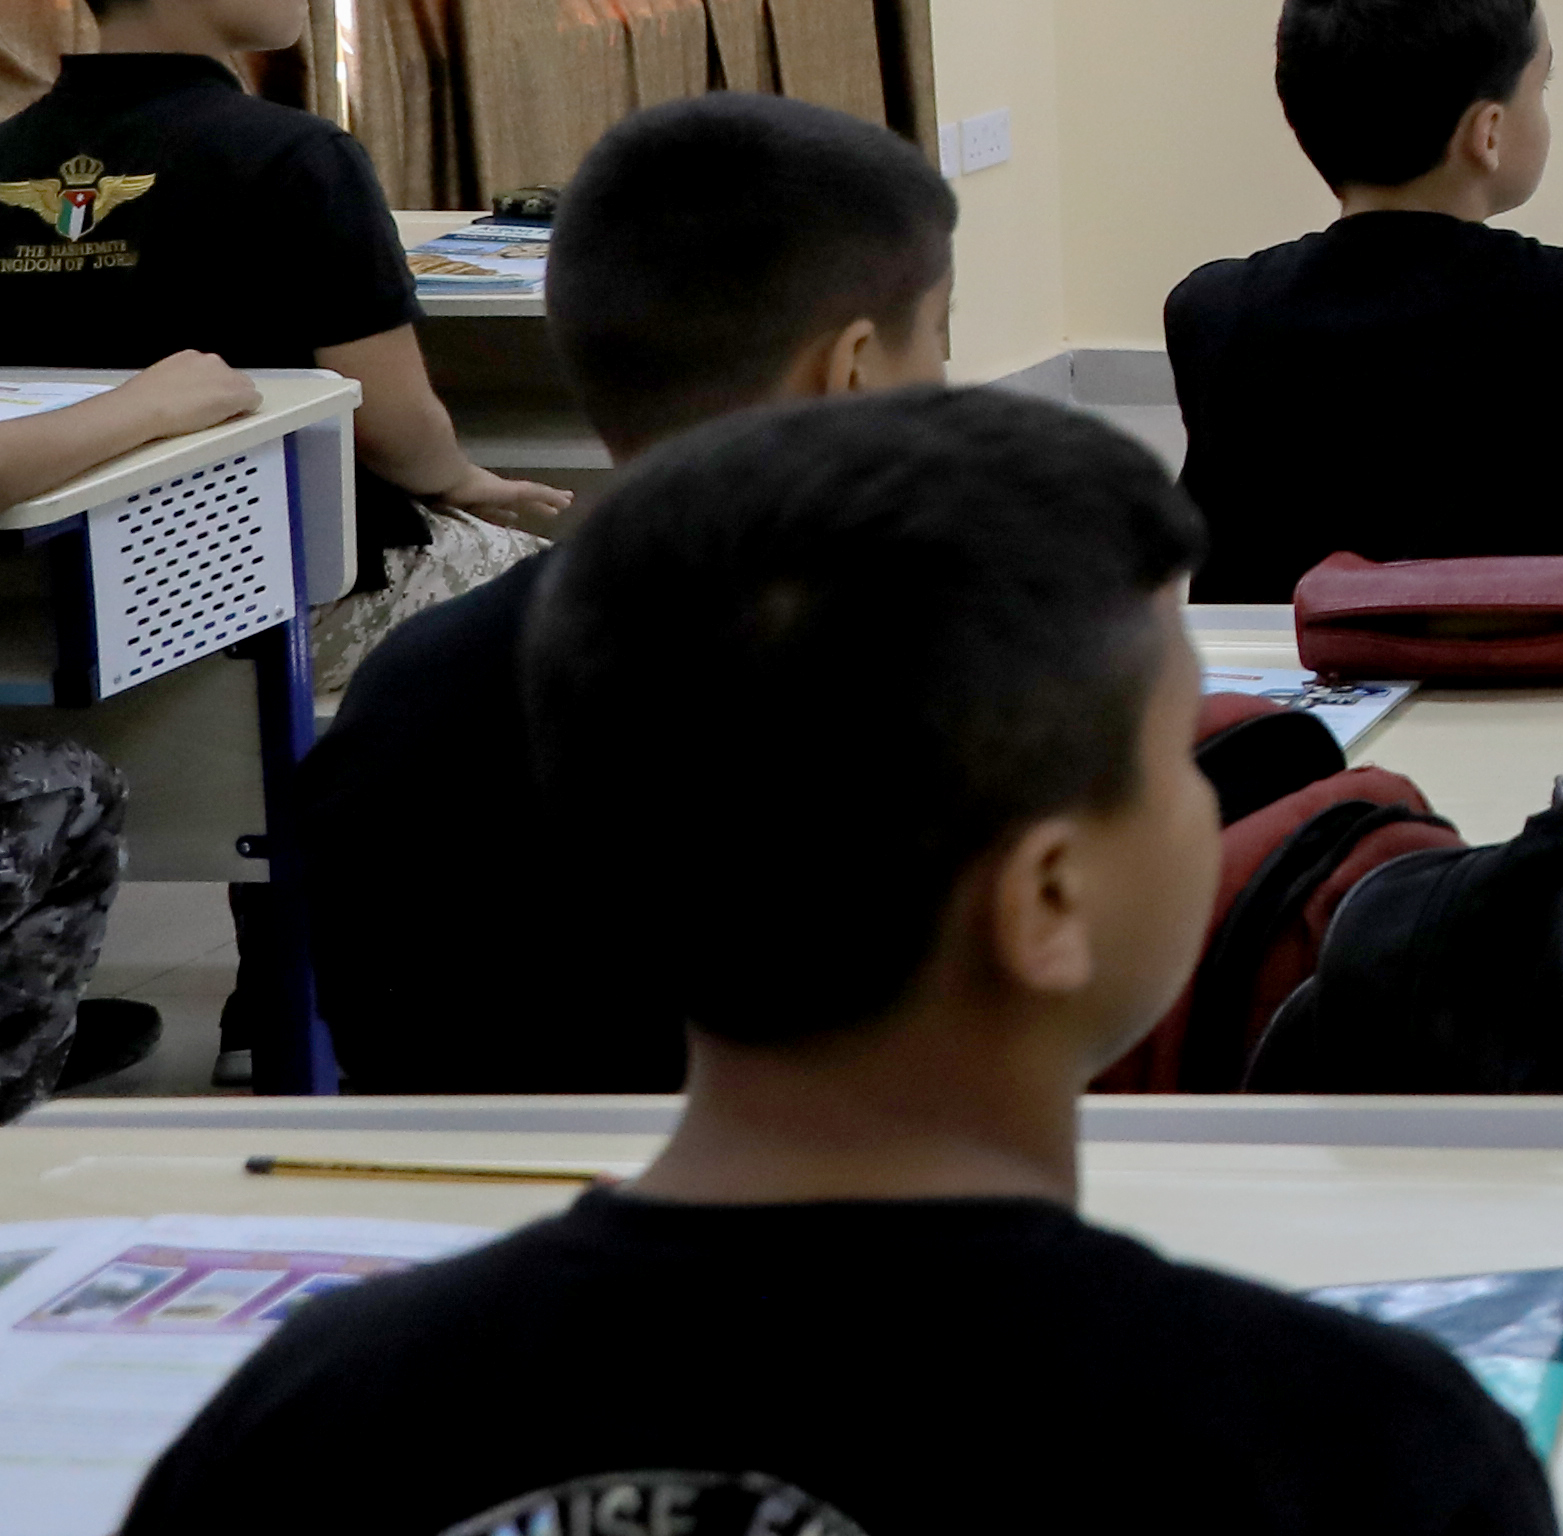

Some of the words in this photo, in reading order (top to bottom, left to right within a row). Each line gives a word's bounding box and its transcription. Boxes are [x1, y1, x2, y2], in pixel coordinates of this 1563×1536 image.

[16, 245, 46, 259] THE
[0, 257, 62, 273] NGDOM
[65, 257, 85, 272] OF
[93, 252, 139, 270] JOR
